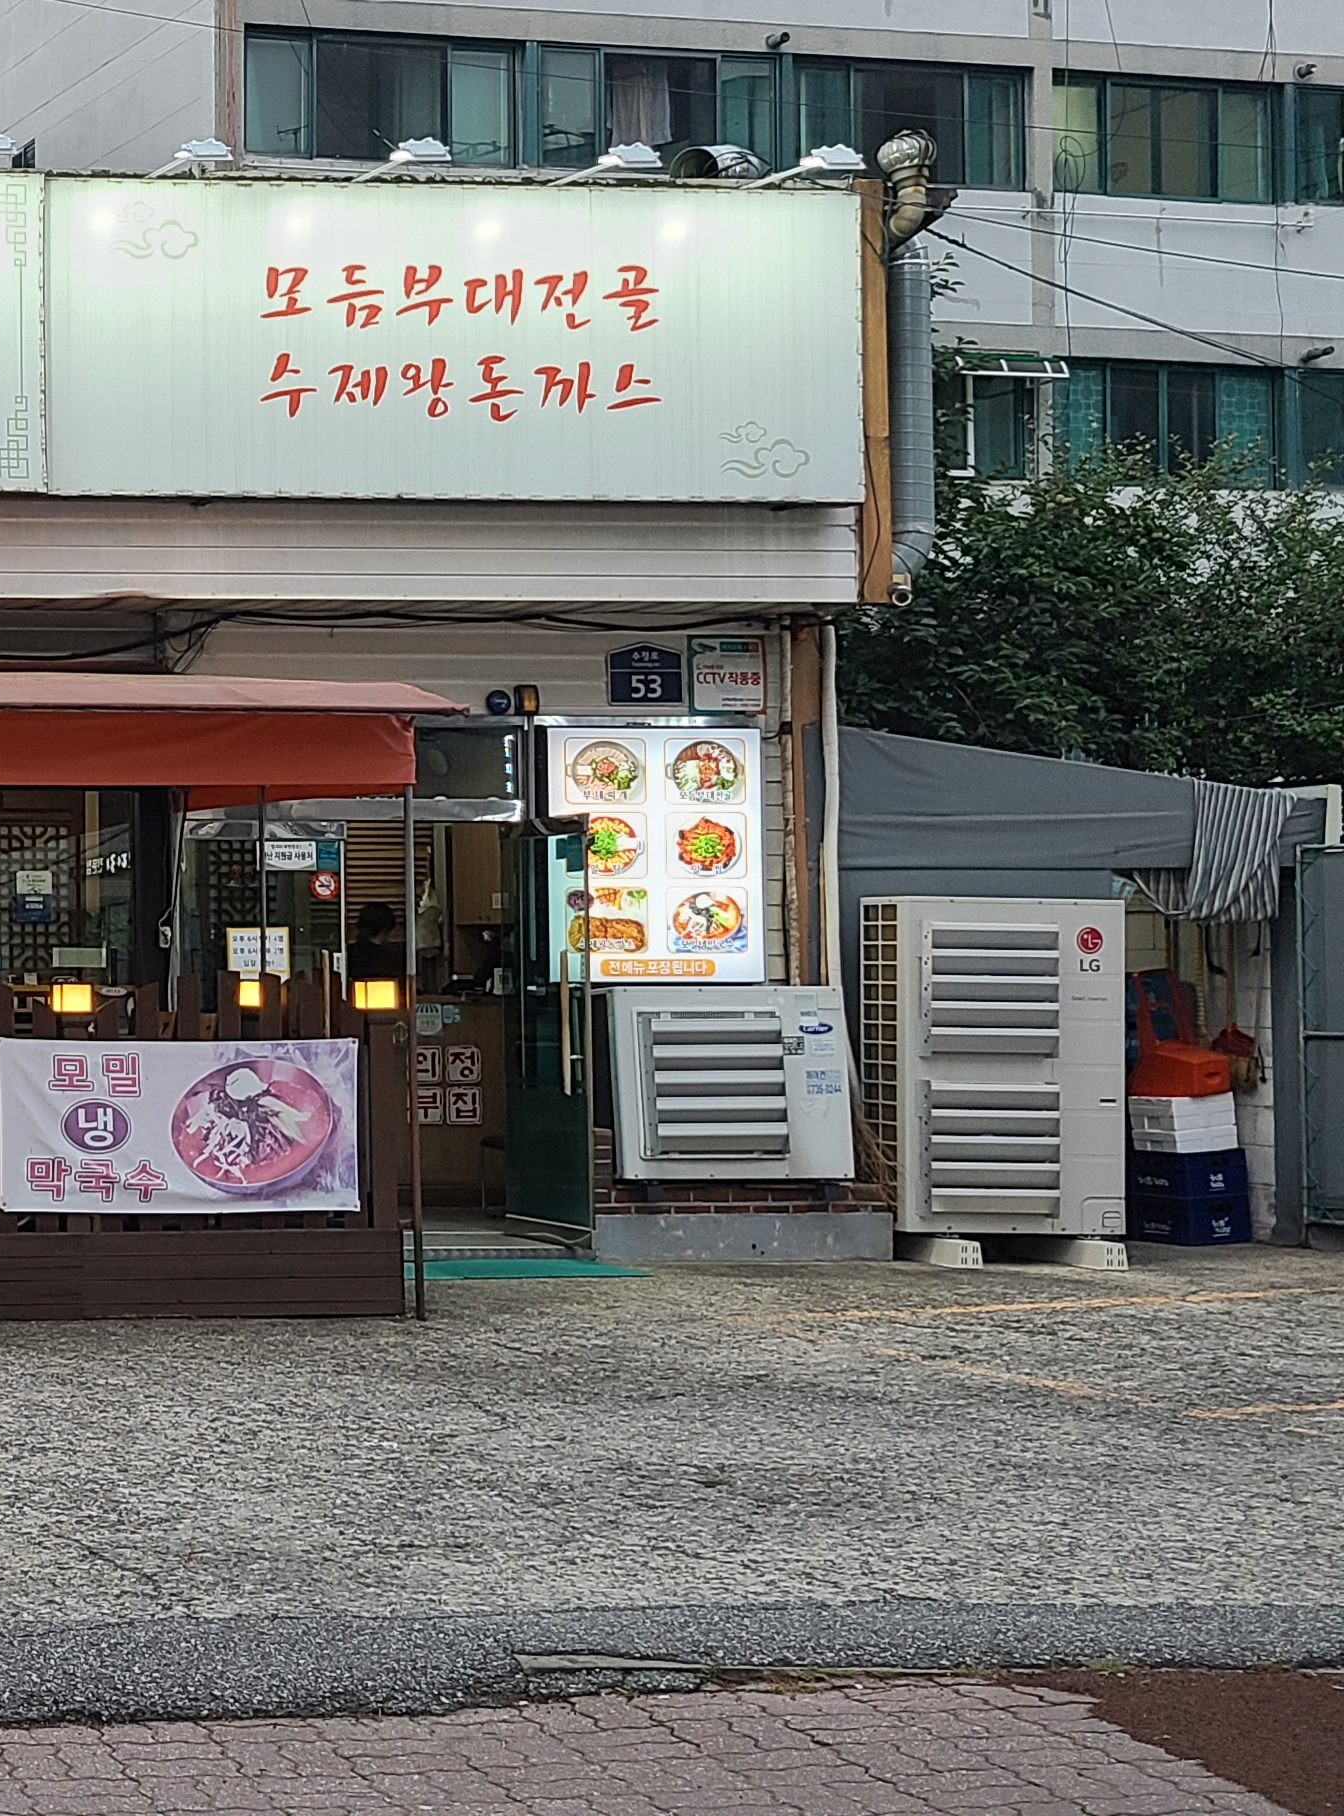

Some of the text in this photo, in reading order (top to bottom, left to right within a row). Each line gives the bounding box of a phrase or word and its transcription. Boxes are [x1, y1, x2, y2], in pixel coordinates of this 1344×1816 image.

[630, 674, 662, 699] 53
[1079, 958, 1101, 973] LG
[47, 1053, 141, 1098] 모밀
[77, 1107, 114, 1148] 냉
[26, 1156, 169, 1203] 막국수
